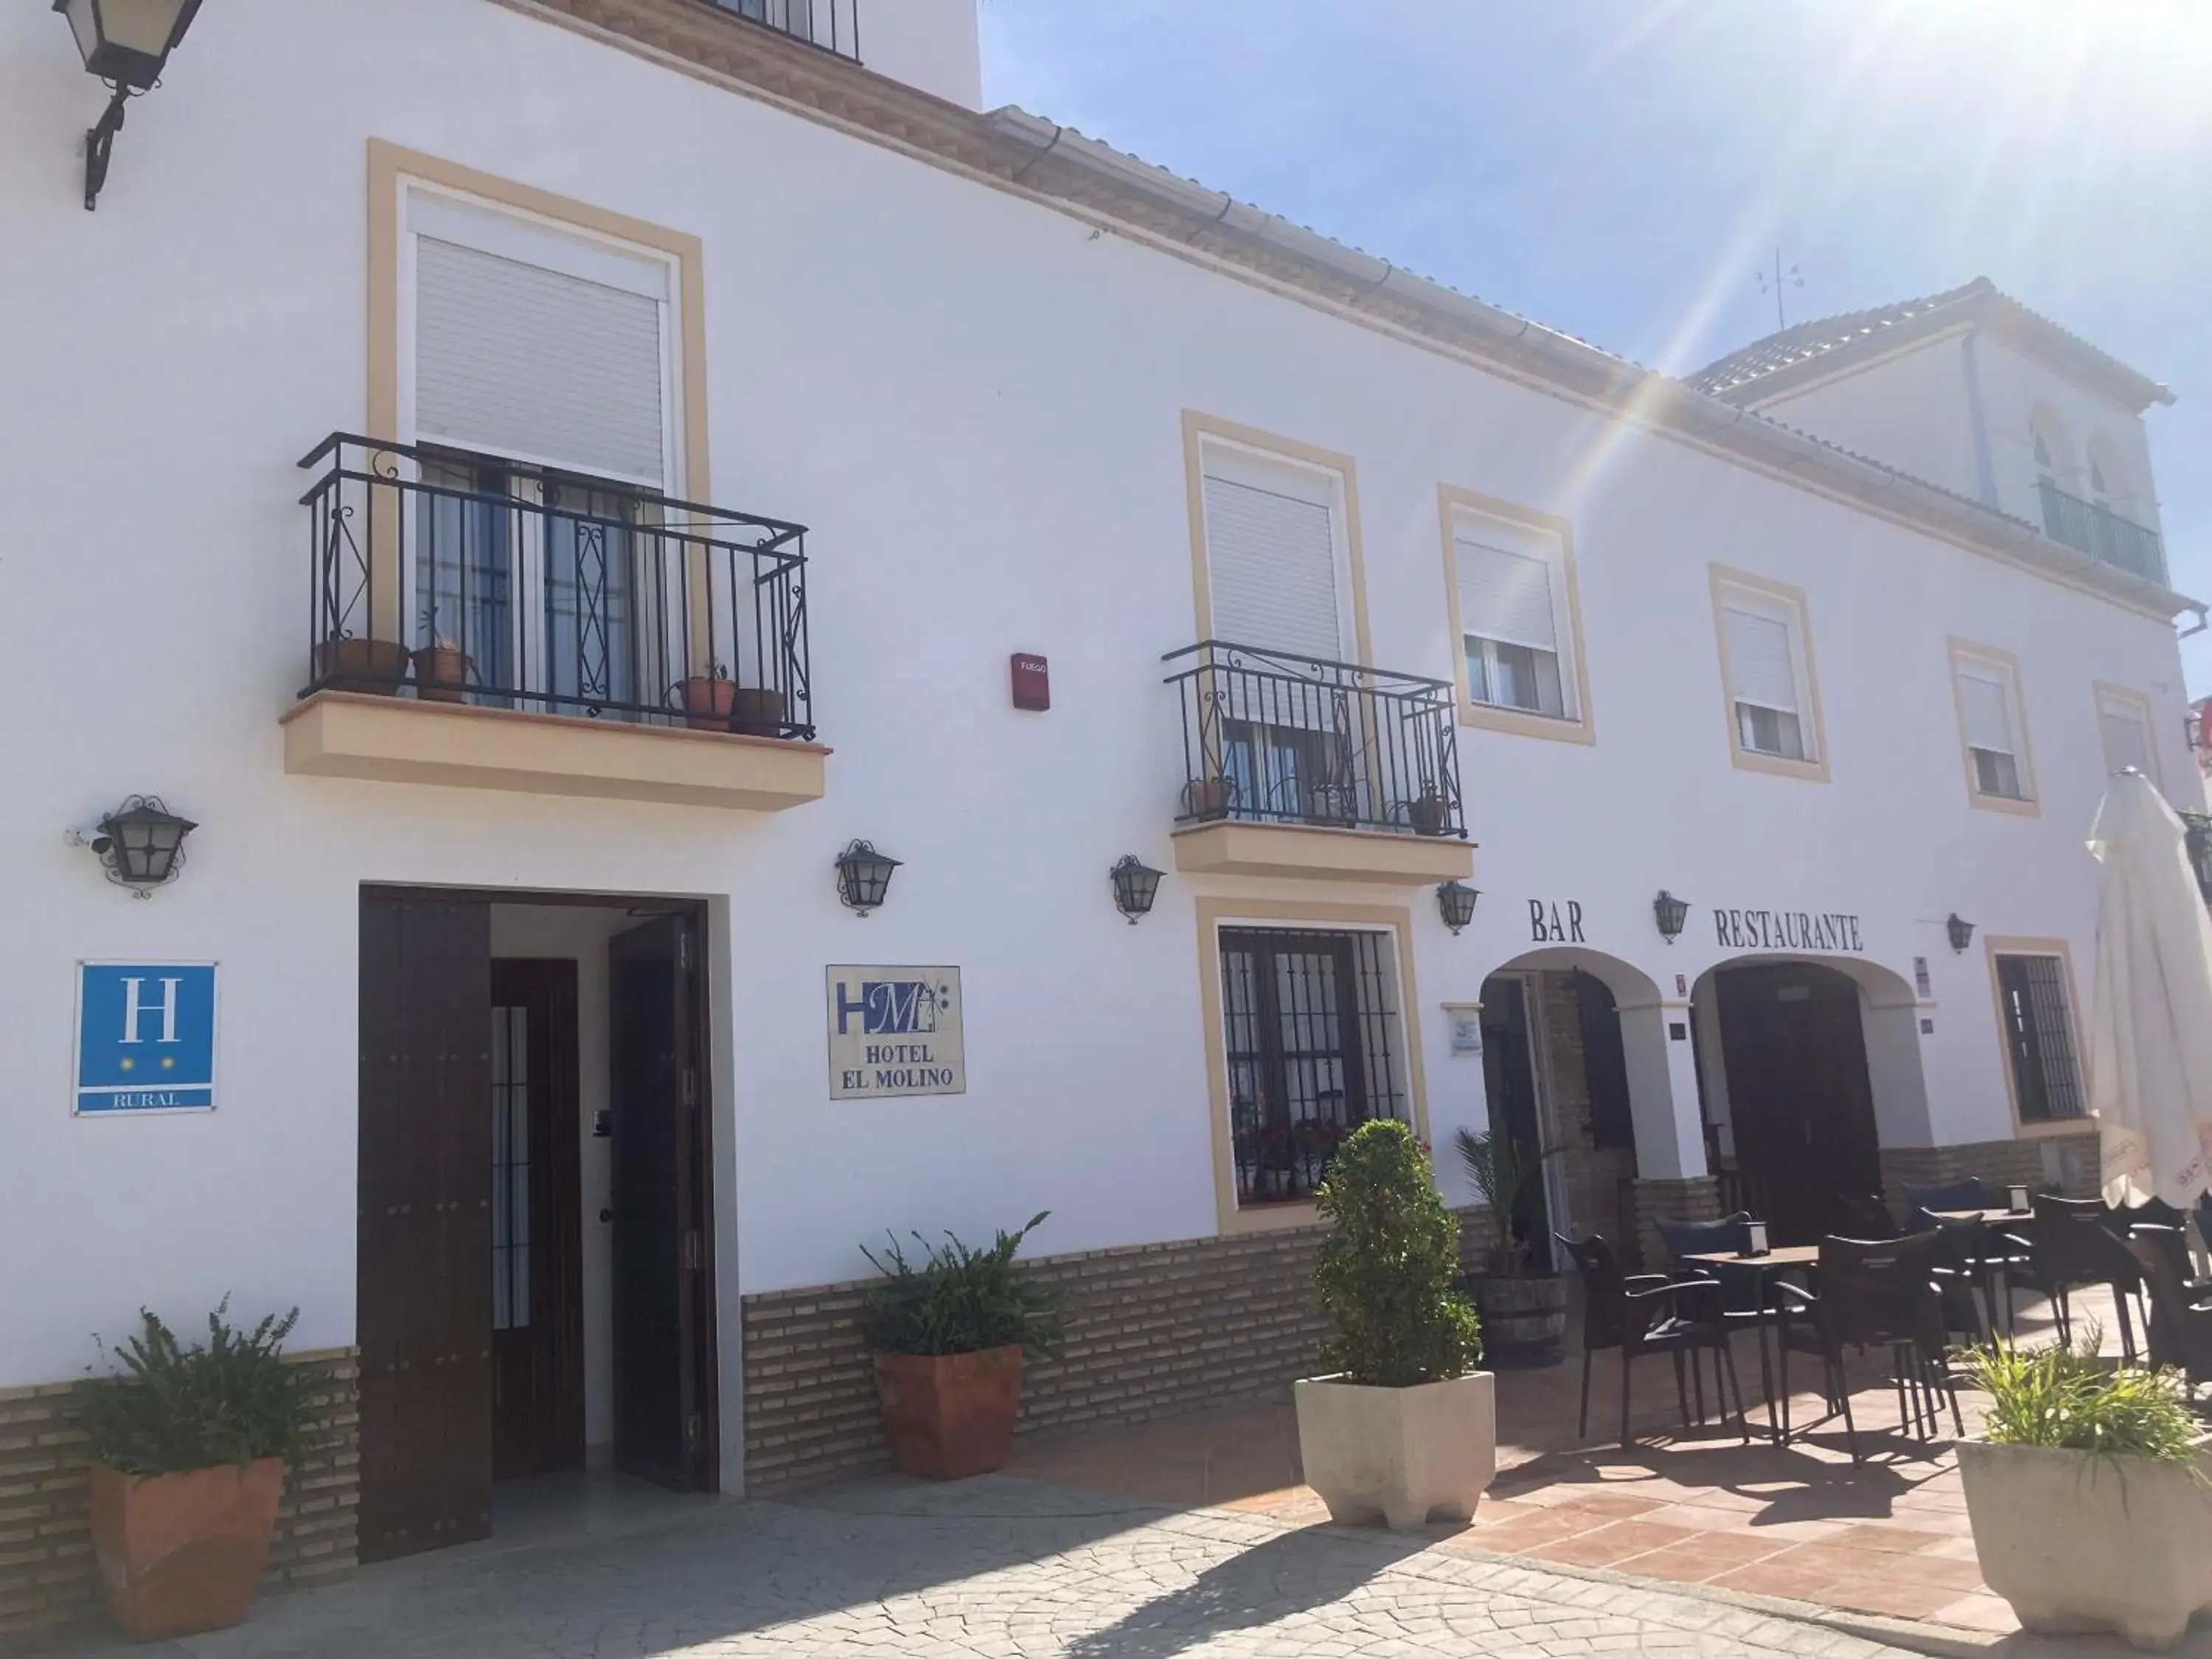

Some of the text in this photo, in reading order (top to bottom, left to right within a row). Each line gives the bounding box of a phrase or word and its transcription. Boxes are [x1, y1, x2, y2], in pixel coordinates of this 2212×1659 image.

[1020, 661, 1046, 673] FUEGO
[1527, 899, 1863, 951] BAR RESTAURANTE
[118, 977, 184, 1043] H
[866, 1044, 934, 1064] HOTEL
[842, 1068, 953, 1089] EL MOLINO
[114, 1092, 180, 1107] RURAL
